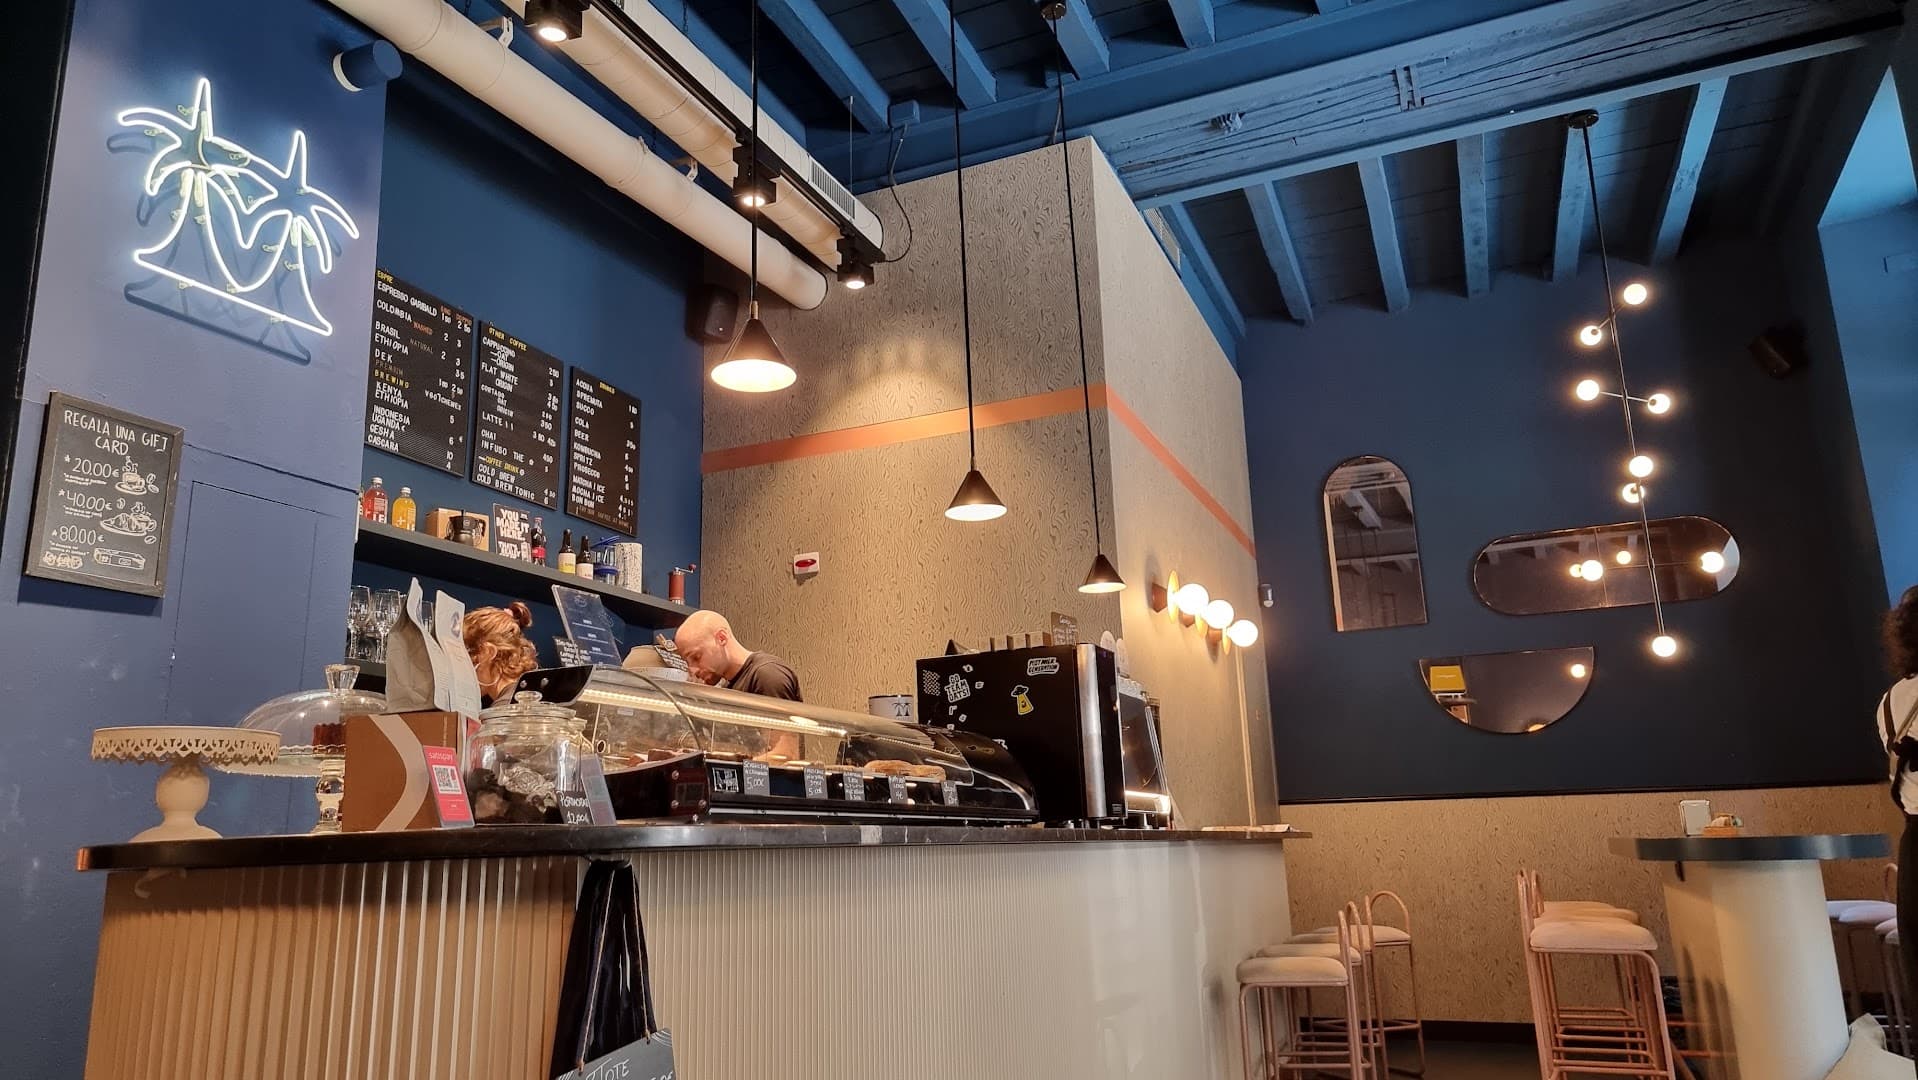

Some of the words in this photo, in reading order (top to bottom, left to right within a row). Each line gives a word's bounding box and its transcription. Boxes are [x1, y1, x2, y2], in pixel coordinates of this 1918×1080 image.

[377, 280, 409, 303] ESPRESSO
[376, 299, 413, 323] COLOMBIA
[443, 332, 449, 342] 2
[374, 332, 409, 356] ETHIOPIA
[375, 320, 401, 340] BRASIL
[410, 338, 434, 356] NATURAL
[441, 350, 446, 360] 2
[509, 337, 528, 352] COFFEE
[374, 369, 410, 389] BREWING
[481, 362, 498, 376] FLAT
[499, 370, 519, 386] WHITE
[376, 381, 402, 398] KENYA
[575, 378, 594, 393] ACQUA
[375, 390, 409, 410] ETHIOPIA
[575, 401, 595, 416] SUCCO
[371, 413, 400, 431] UGANDA
[373, 404, 411, 426] INDONESIA
[482, 411, 503, 427] LATTE
[574, 416, 590, 430] COLA
[64, 409, 110, 437] REGALA
[115, 424, 136, 442] UNA
[141, 432, 169, 452] GIFT
[369, 423, 395, 440] GESHA
[481, 429, 496, 441] CHAI
[574, 428, 589, 442] BEER
[95, 436, 129, 456] CARD
[367, 434, 399, 453] CASCARA
[481, 440, 508, 456] INFUSO
[513, 451, 525, 463] THE
[478, 464, 496, 476] COLD
[498, 471, 516, 484] BREW
[476, 473, 492, 485] COLD
[514, 486, 535, 500] TONIC
[500, 508, 519, 521] YOU
[495, 516, 520, 531] MADE
[520, 521, 530, 534] IT
[945, 680, 968, 694] TEAM
[950, 674, 960, 684] GO
